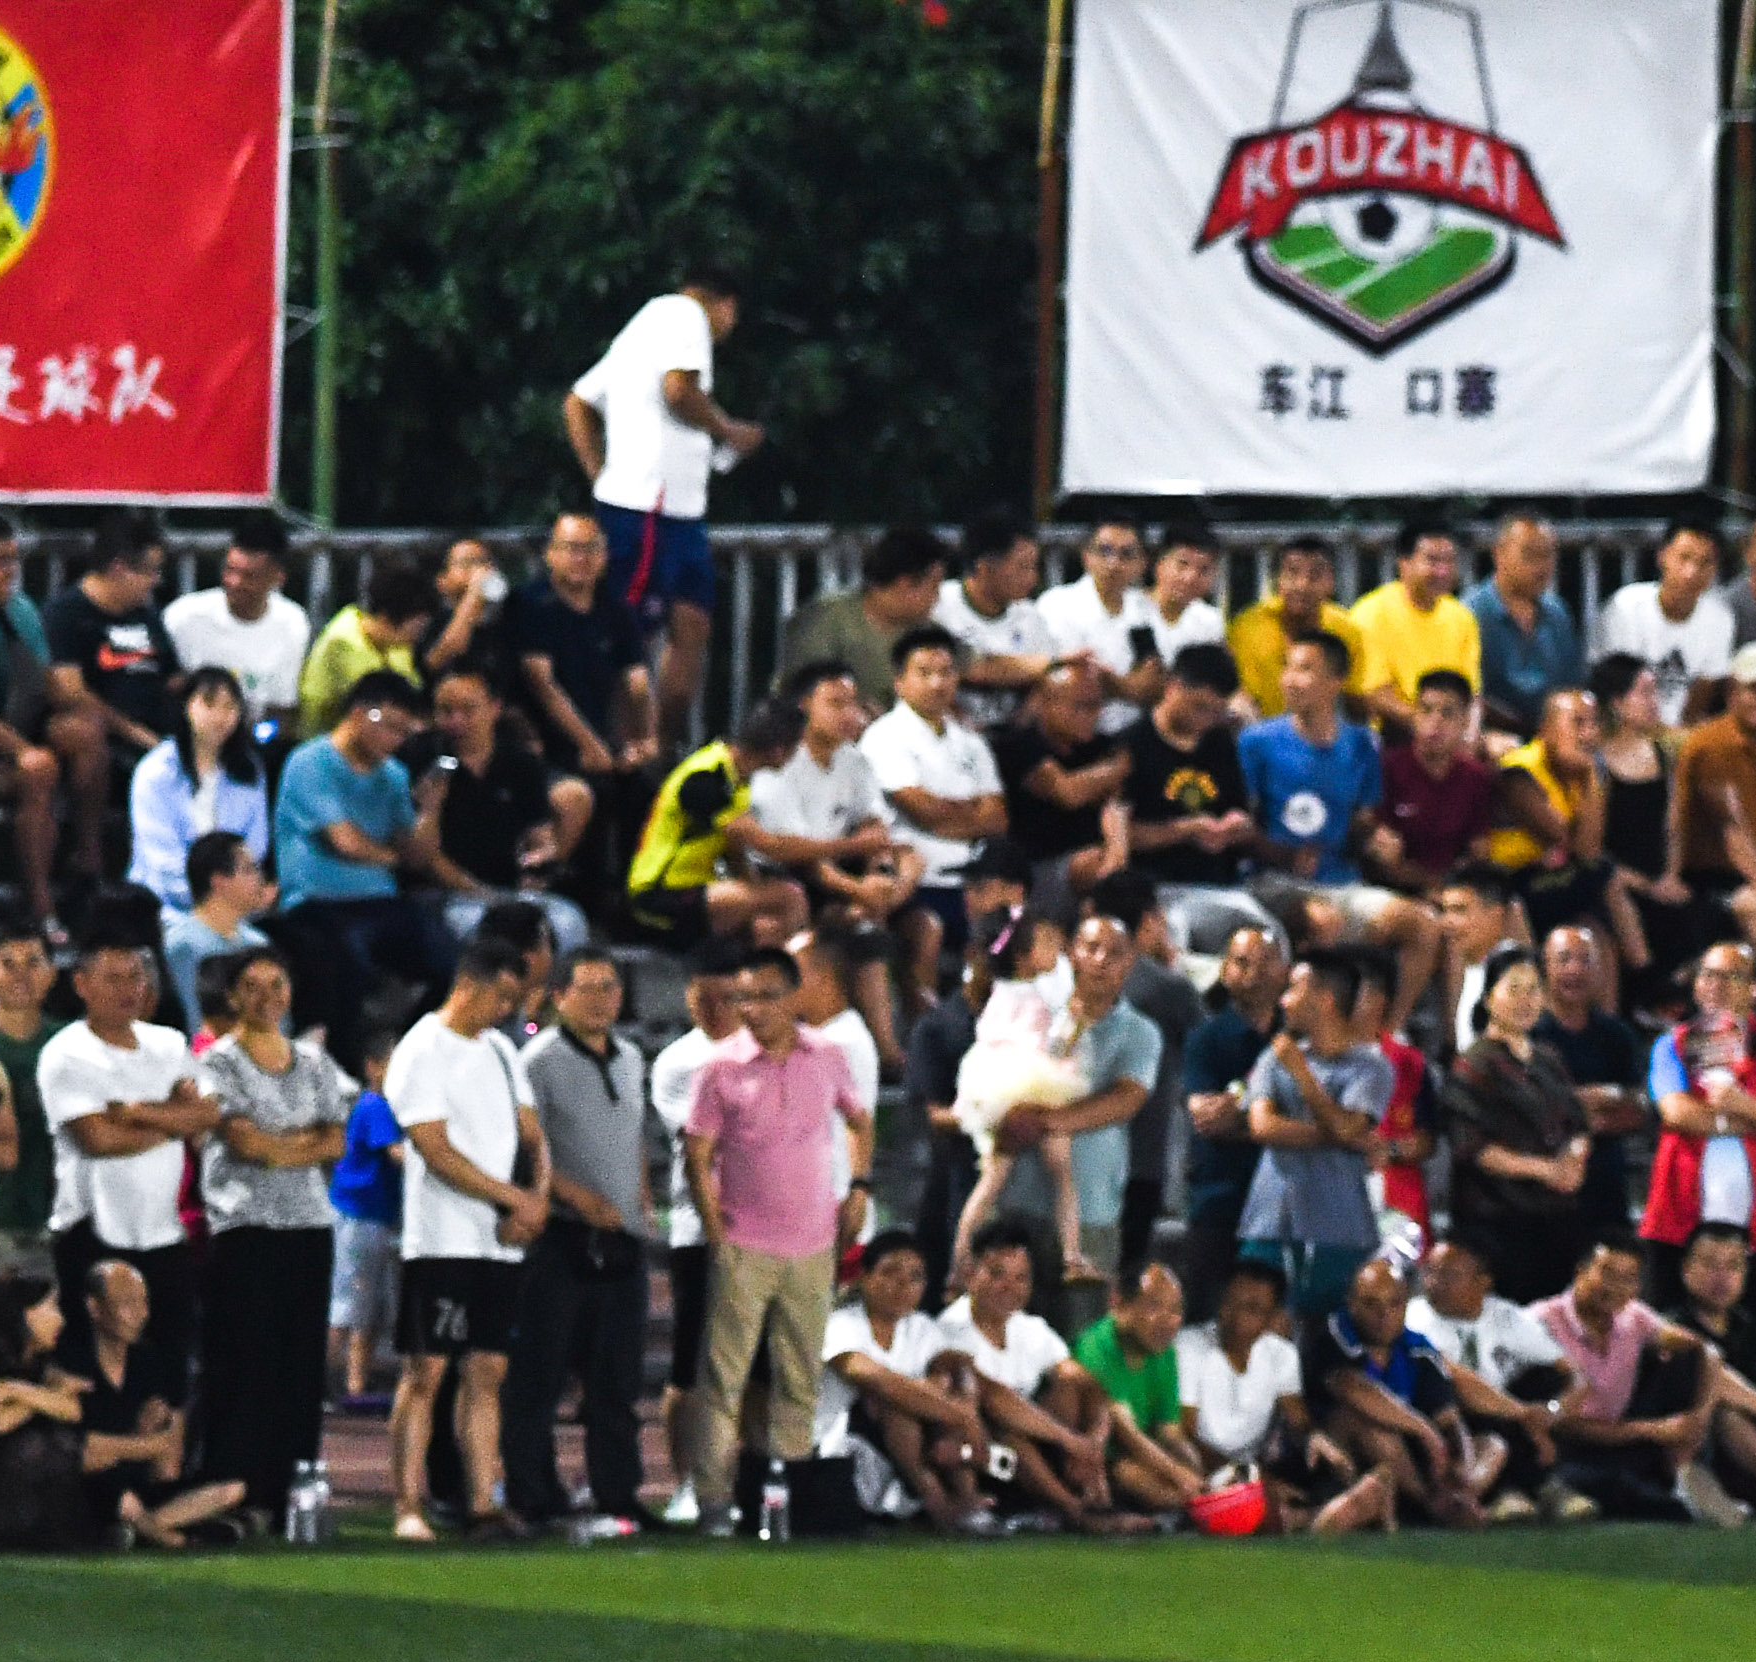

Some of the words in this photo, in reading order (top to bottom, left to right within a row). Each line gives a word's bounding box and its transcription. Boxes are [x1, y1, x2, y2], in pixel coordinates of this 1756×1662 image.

[1241, 119, 1522, 212] KOUZHAI
[1258, 363, 1350, 421] 车江
[1405, 365, 1498, 419] 口寨
